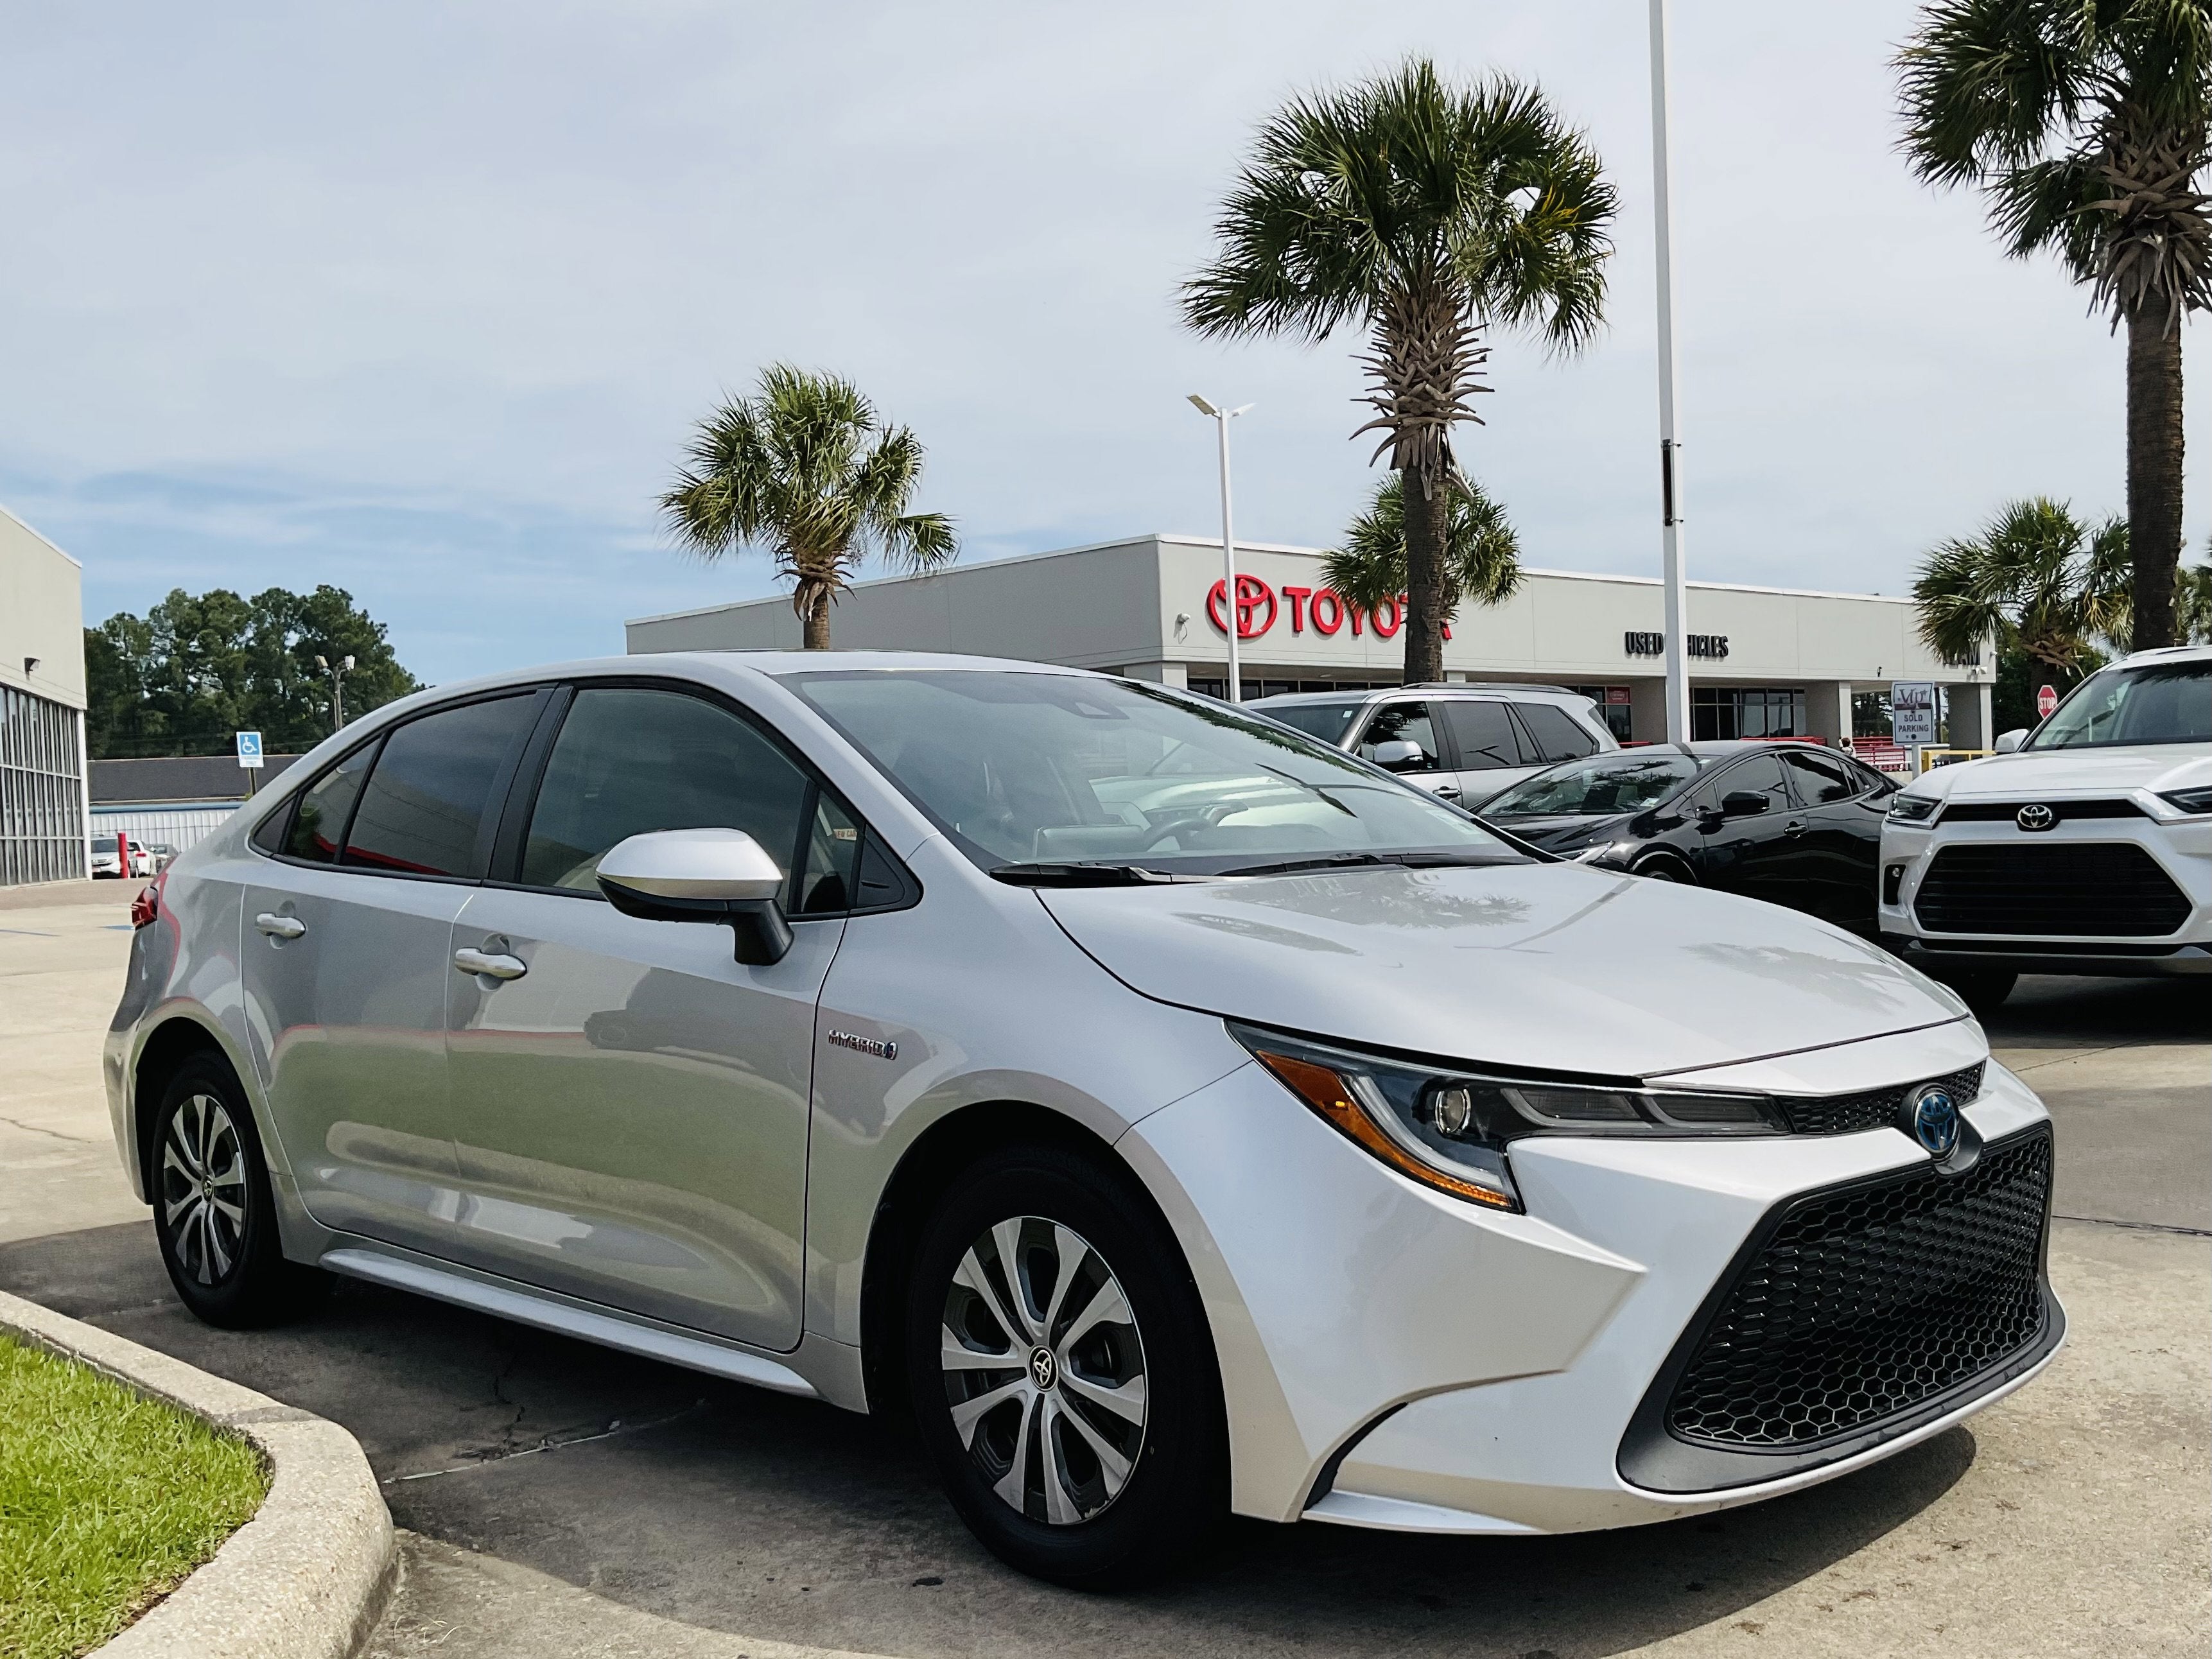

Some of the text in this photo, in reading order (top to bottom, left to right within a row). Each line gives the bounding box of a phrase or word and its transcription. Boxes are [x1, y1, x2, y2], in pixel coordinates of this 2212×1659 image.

[1282, 586, 1452, 639] TOYO
[1624, 632, 1729, 657] USED HICLES
[2039, 697, 2056, 709] STOP
[1898, 724, 1929, 733] PARKING
[828, 1029, 885, 1057] HYBRID
